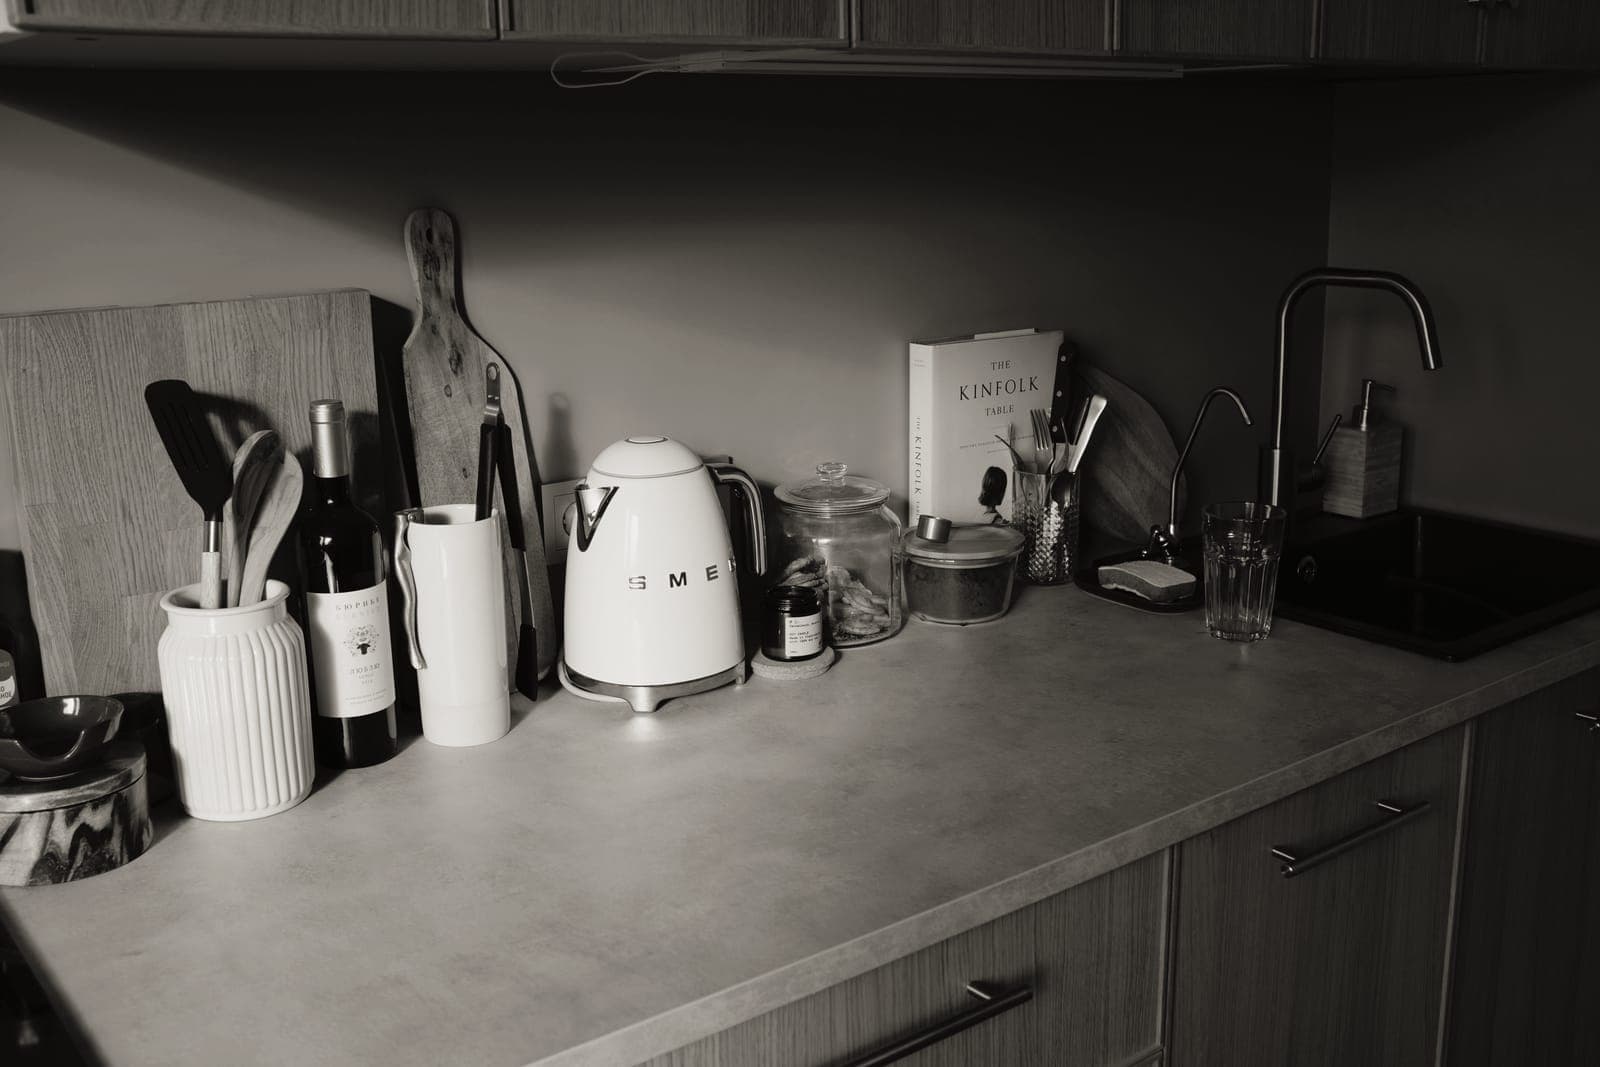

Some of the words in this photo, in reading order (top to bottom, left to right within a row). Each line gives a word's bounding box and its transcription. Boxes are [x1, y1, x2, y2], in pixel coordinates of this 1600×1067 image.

[990, 359, 1012, 371] THE
[959, 375, 1040, 401] KINFOLK
[984, 404, 1015, 417] TABLE
[914, 436, 923, 495] KINFOLK
